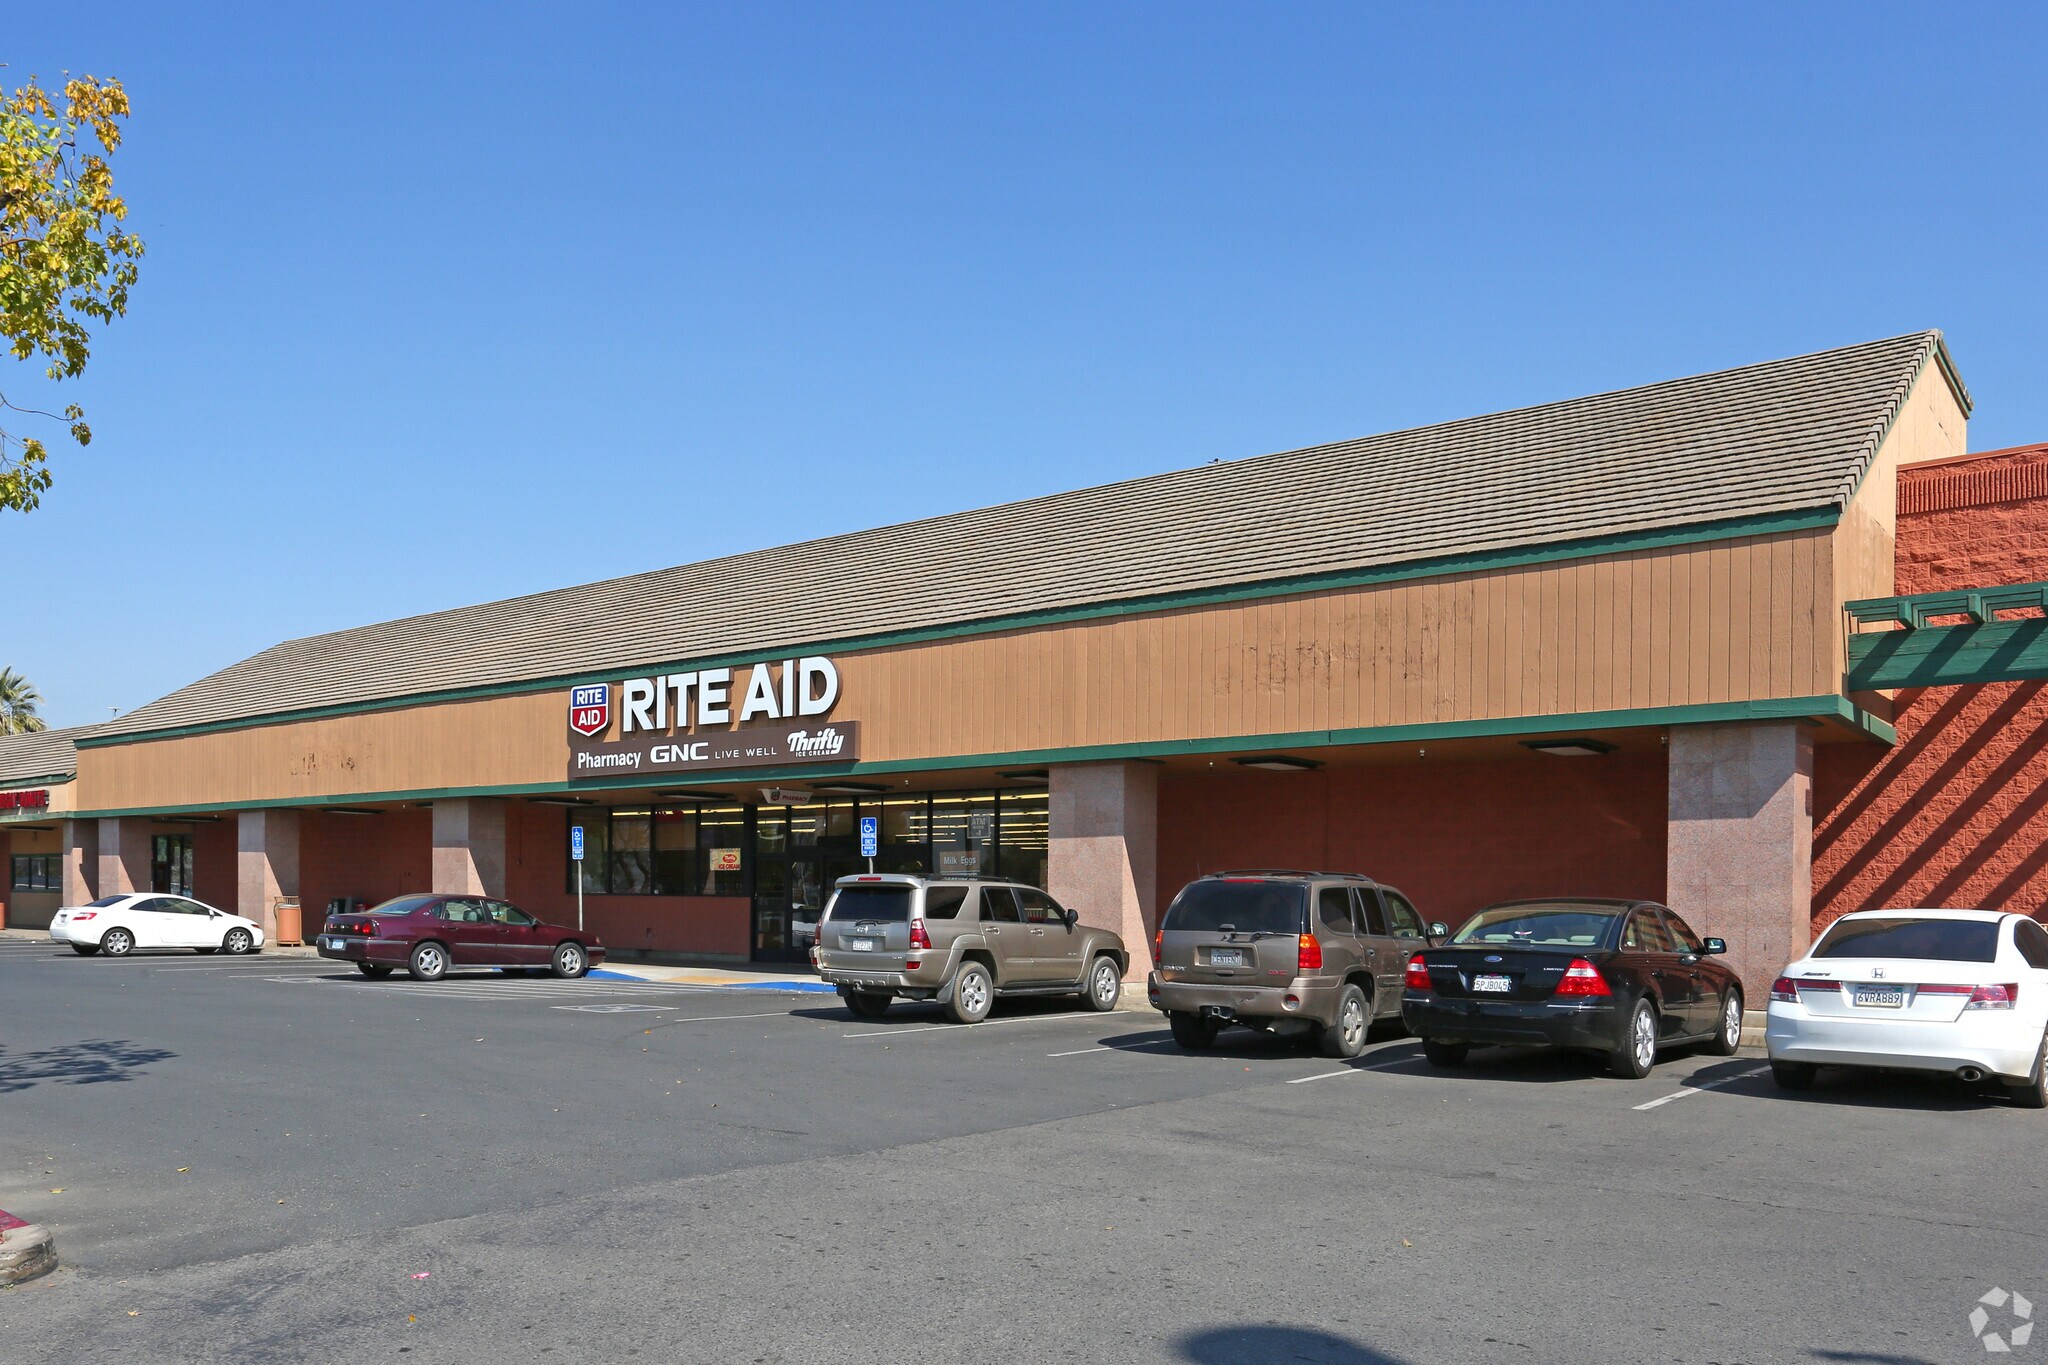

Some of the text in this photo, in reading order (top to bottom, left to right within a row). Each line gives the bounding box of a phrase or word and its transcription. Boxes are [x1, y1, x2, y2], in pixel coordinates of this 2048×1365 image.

[577, 688, 603, 705] RITE
[623, 656, 838, 732] RITE AID
[578, 709, 600, 726] AID
[787, 727, 845, 755] Thrifty
[577, 750, 642, 769] Pharmacy
[650, 741, 709, 764] GNC
[715, 746, 777, 759] LIVE WELL
[808, 749, 830, 757] CREAM
[971, 818, 986, 826] ATM
[944, 856, 977, 865] Milk Eggs
[1475, 980, 1508, 990] 5PJB045
[1857, 992, 1900, 1003] 6VRA889
